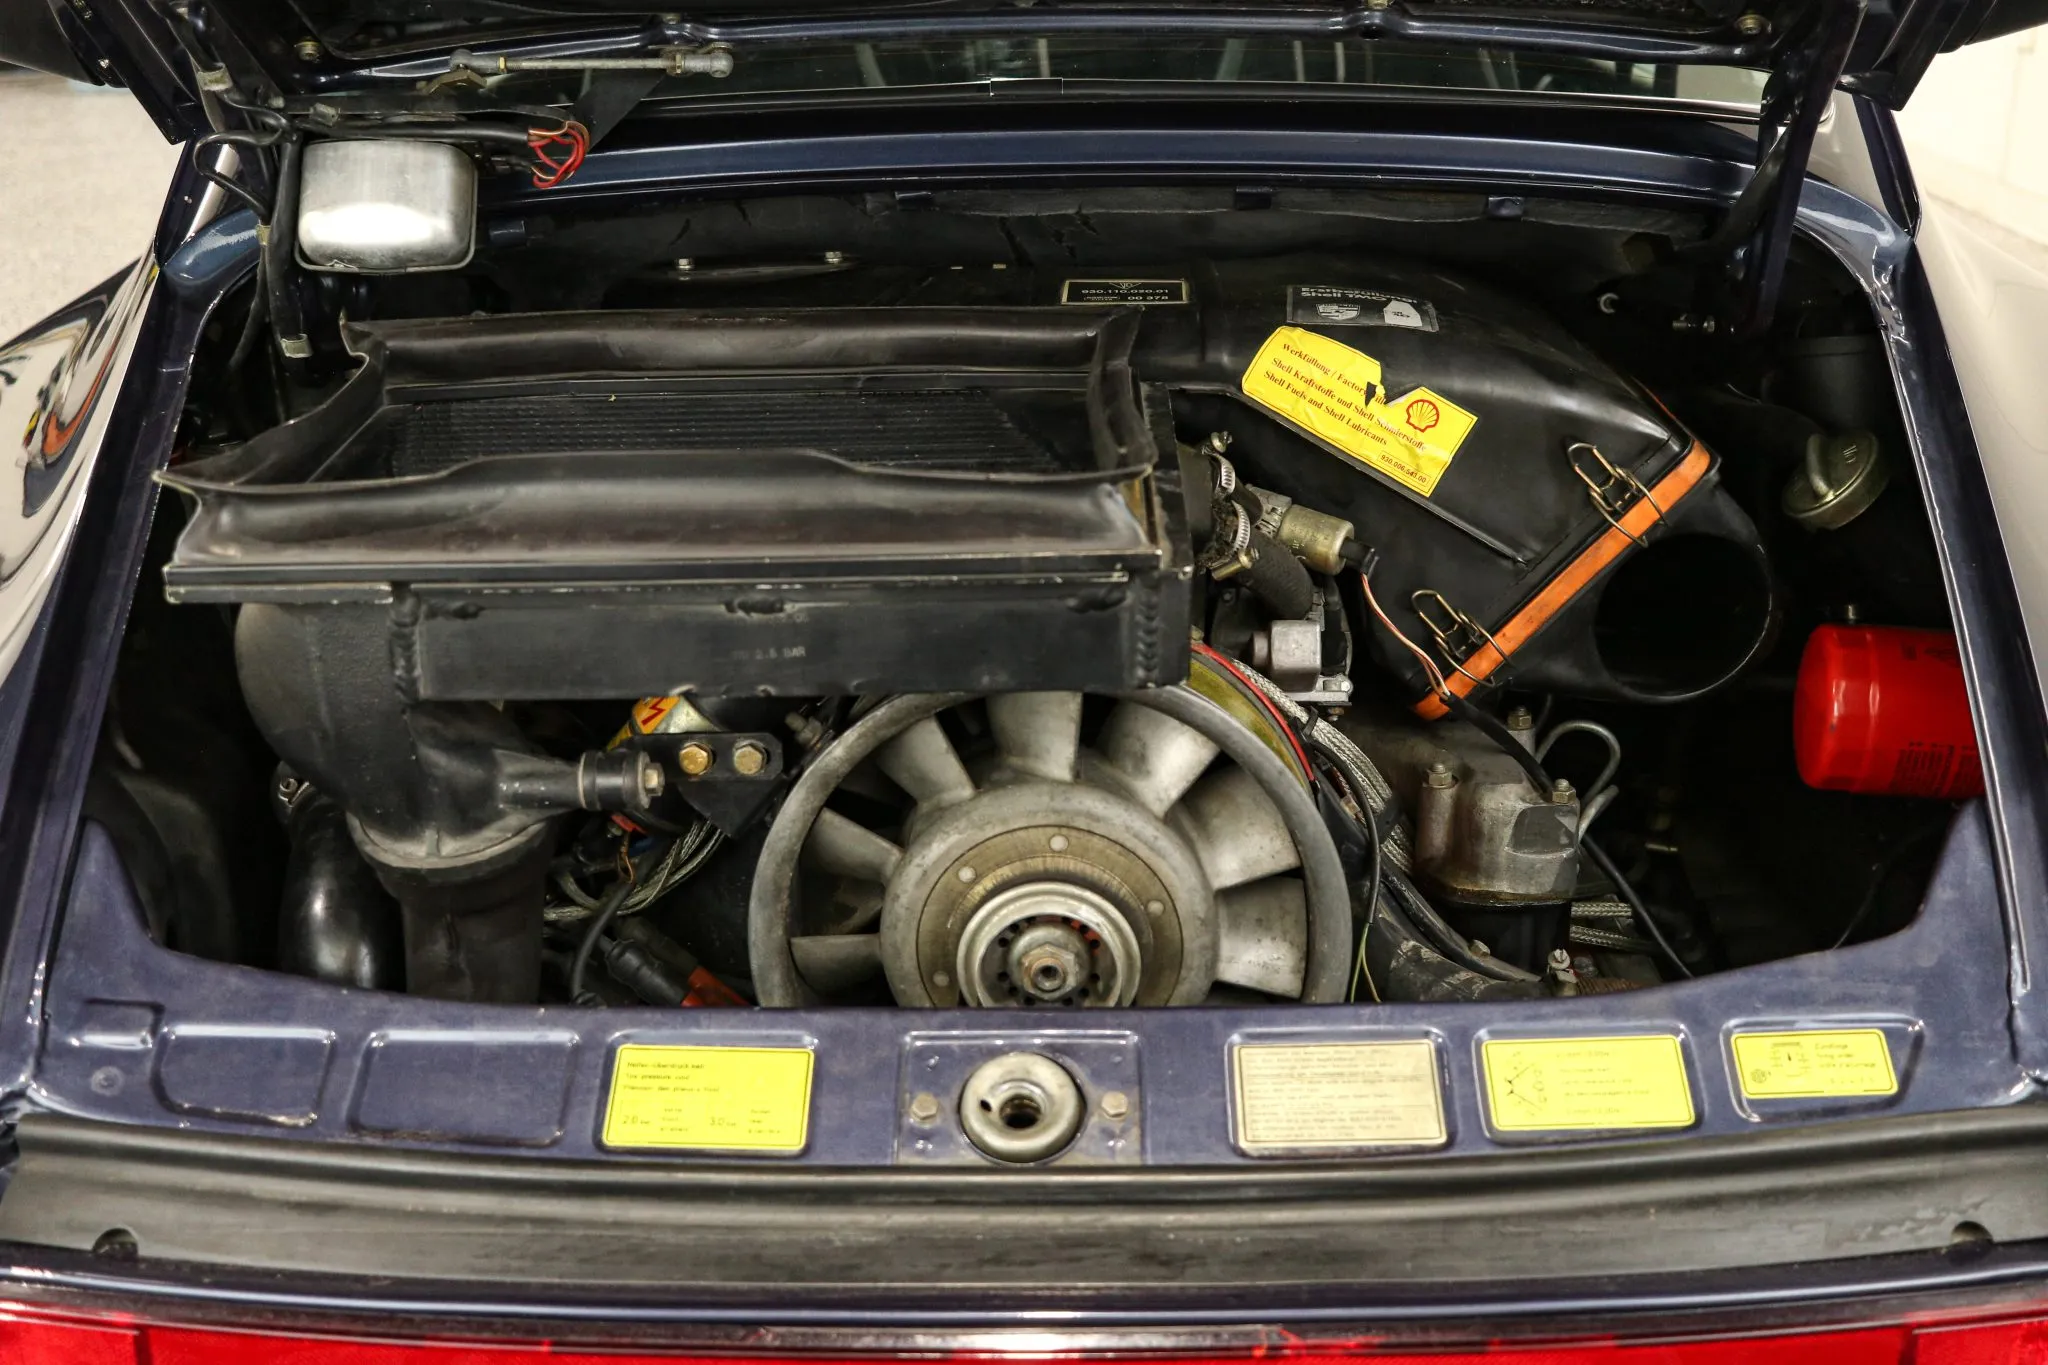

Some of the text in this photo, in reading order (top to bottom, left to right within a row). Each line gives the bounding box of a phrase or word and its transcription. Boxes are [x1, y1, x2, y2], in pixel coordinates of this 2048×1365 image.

[1263, 370, 1388, 446] Shell Fuels and Shell Lubricants
[1271, 357, 1294, 375] Shell
[1293, 370, 1336, 400] Kraftstoffe
[1336, 397, 1353, 409] und
[1352, 404, 1375, 422] Shell
